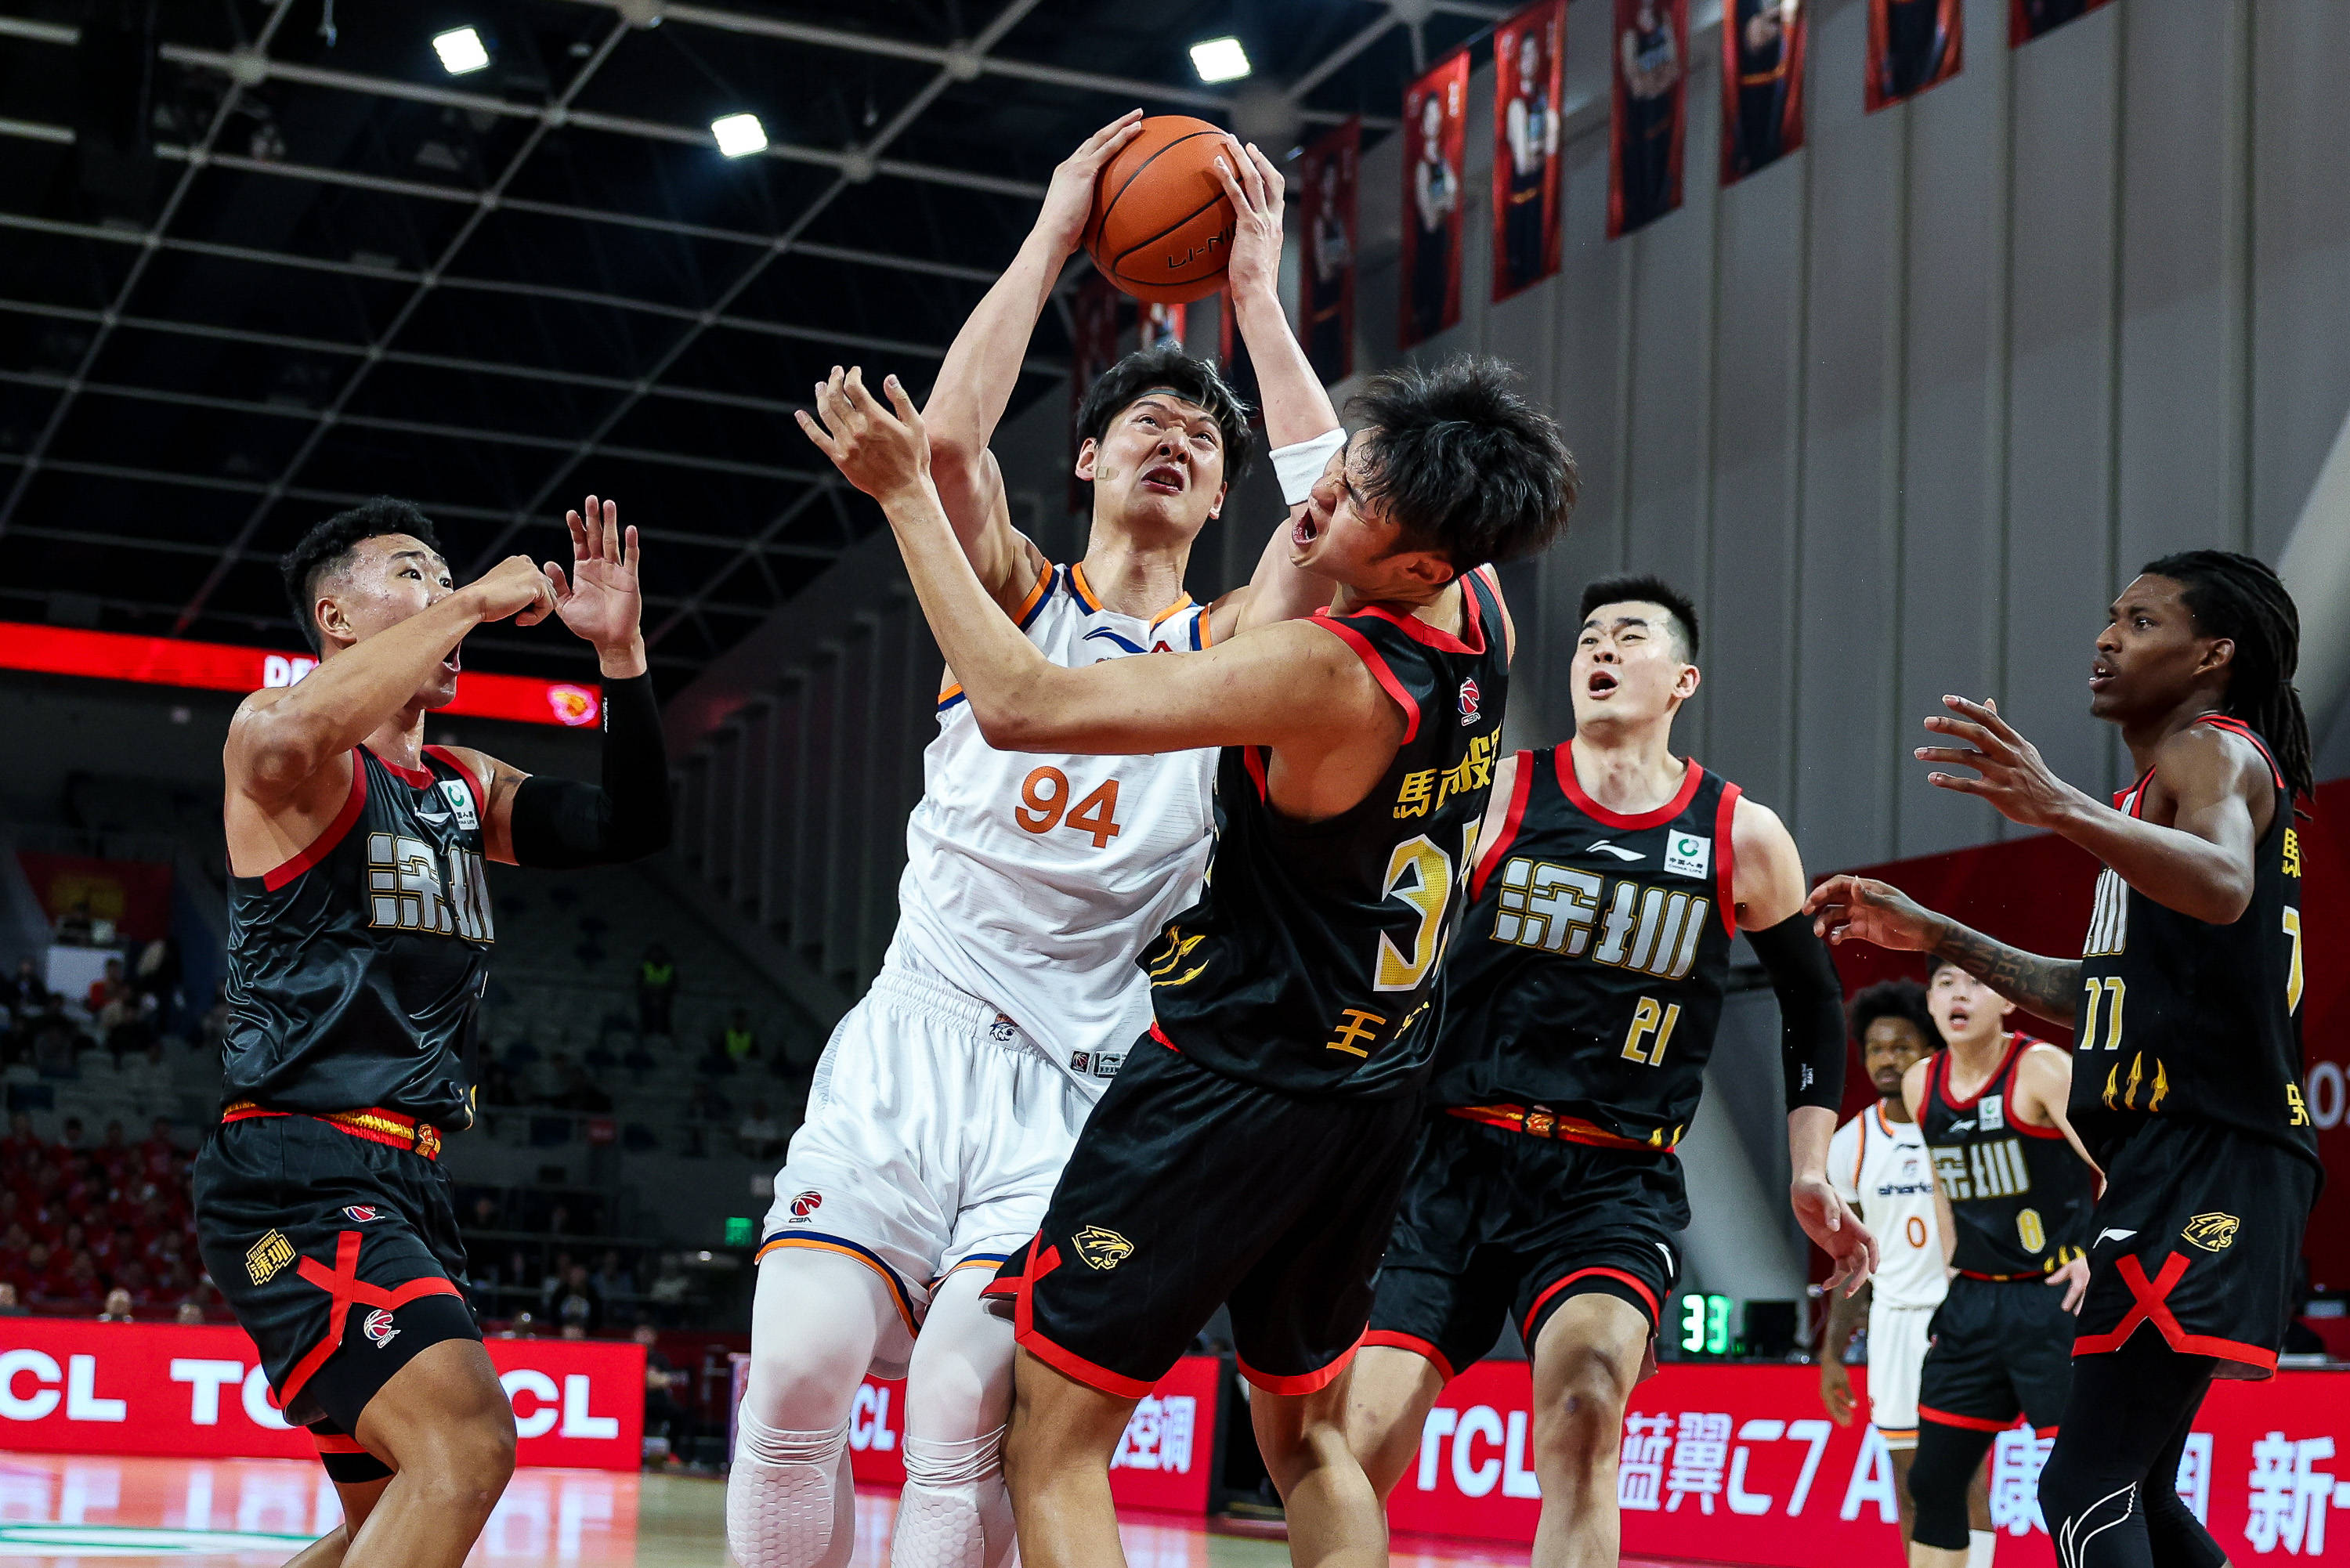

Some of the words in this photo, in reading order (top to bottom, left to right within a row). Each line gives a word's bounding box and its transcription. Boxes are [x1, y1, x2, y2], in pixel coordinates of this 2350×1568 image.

[1168, 220, 1237, 268] LI-NI
[1015, 766, 1120, 849] 94
[367, 832, 495, 943] 深圳
[1373, 813, 1480, 992] 3
[1489, 857, 1710, 981] 深圳
[1621, 996, 1680, 1067] 21
[2305, 1060, 2350, 1130] 0
[249, 1238, 292, 1280] 深圳
[1906, 1216, 1927, 1249] 0
[2016, 1208, 2047, 1254] 8
[1682, 1294, 1732, 1354] 33
[1417, 1404, 1543, 1498] TCL
